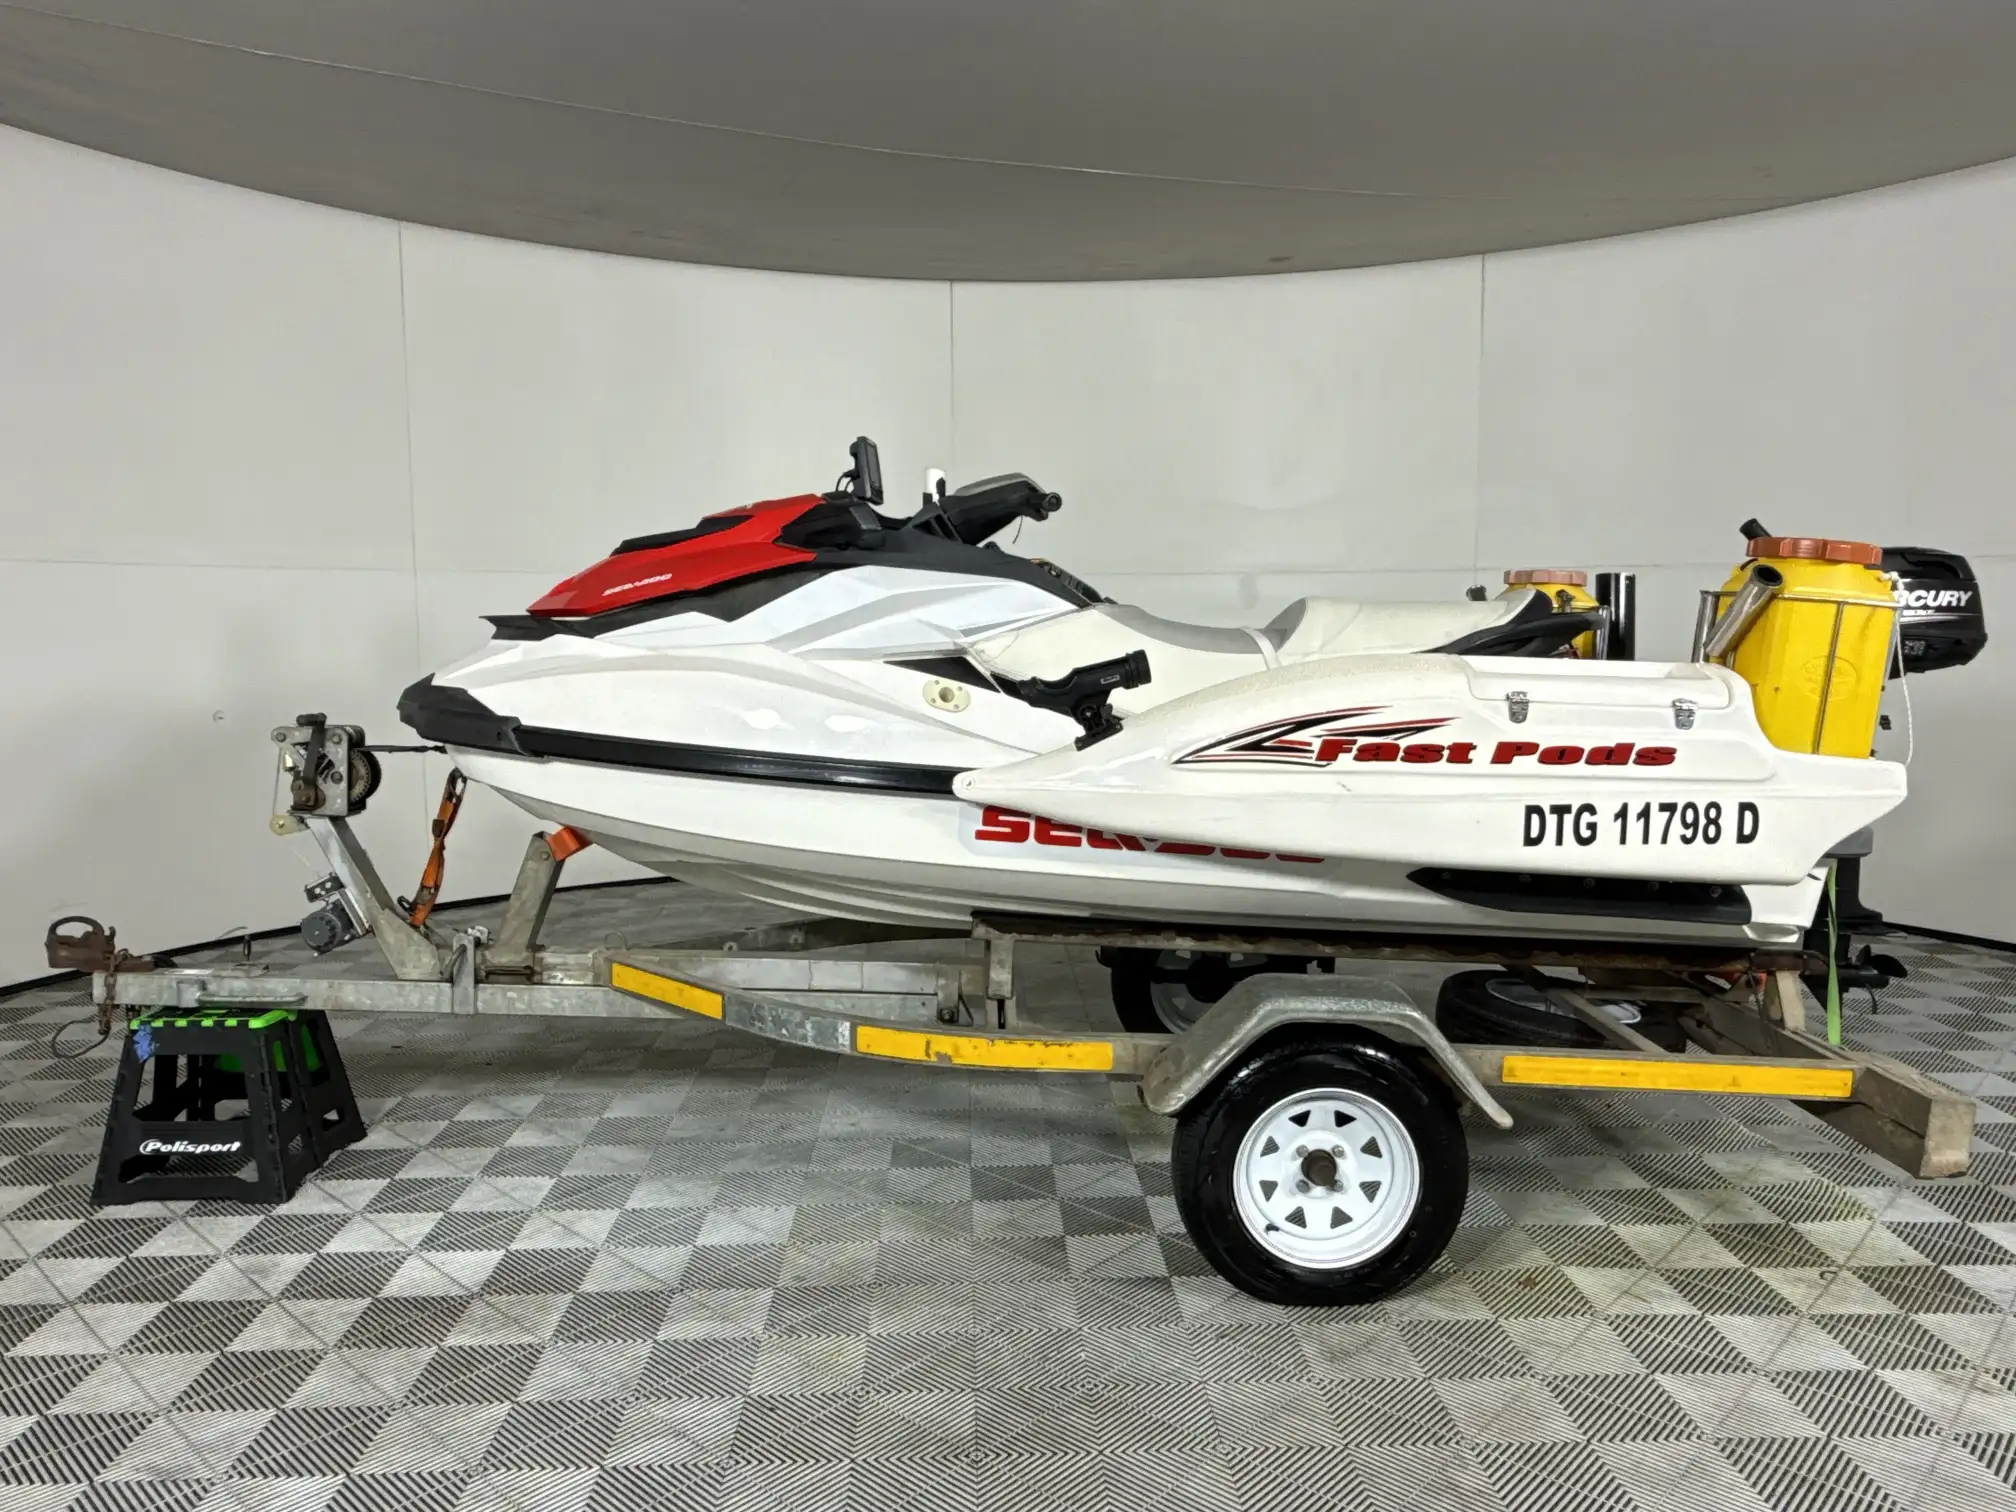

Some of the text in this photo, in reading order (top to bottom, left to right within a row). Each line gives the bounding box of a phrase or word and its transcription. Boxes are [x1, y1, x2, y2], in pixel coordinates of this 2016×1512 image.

[1893, 589, 1973, 608] RCURY
[1315, 738, 1677, 766] Fast Pods
[1523, 800, 1760, 847] DTG 11798 D
[139, 1139, 242, 1155] Polisport
